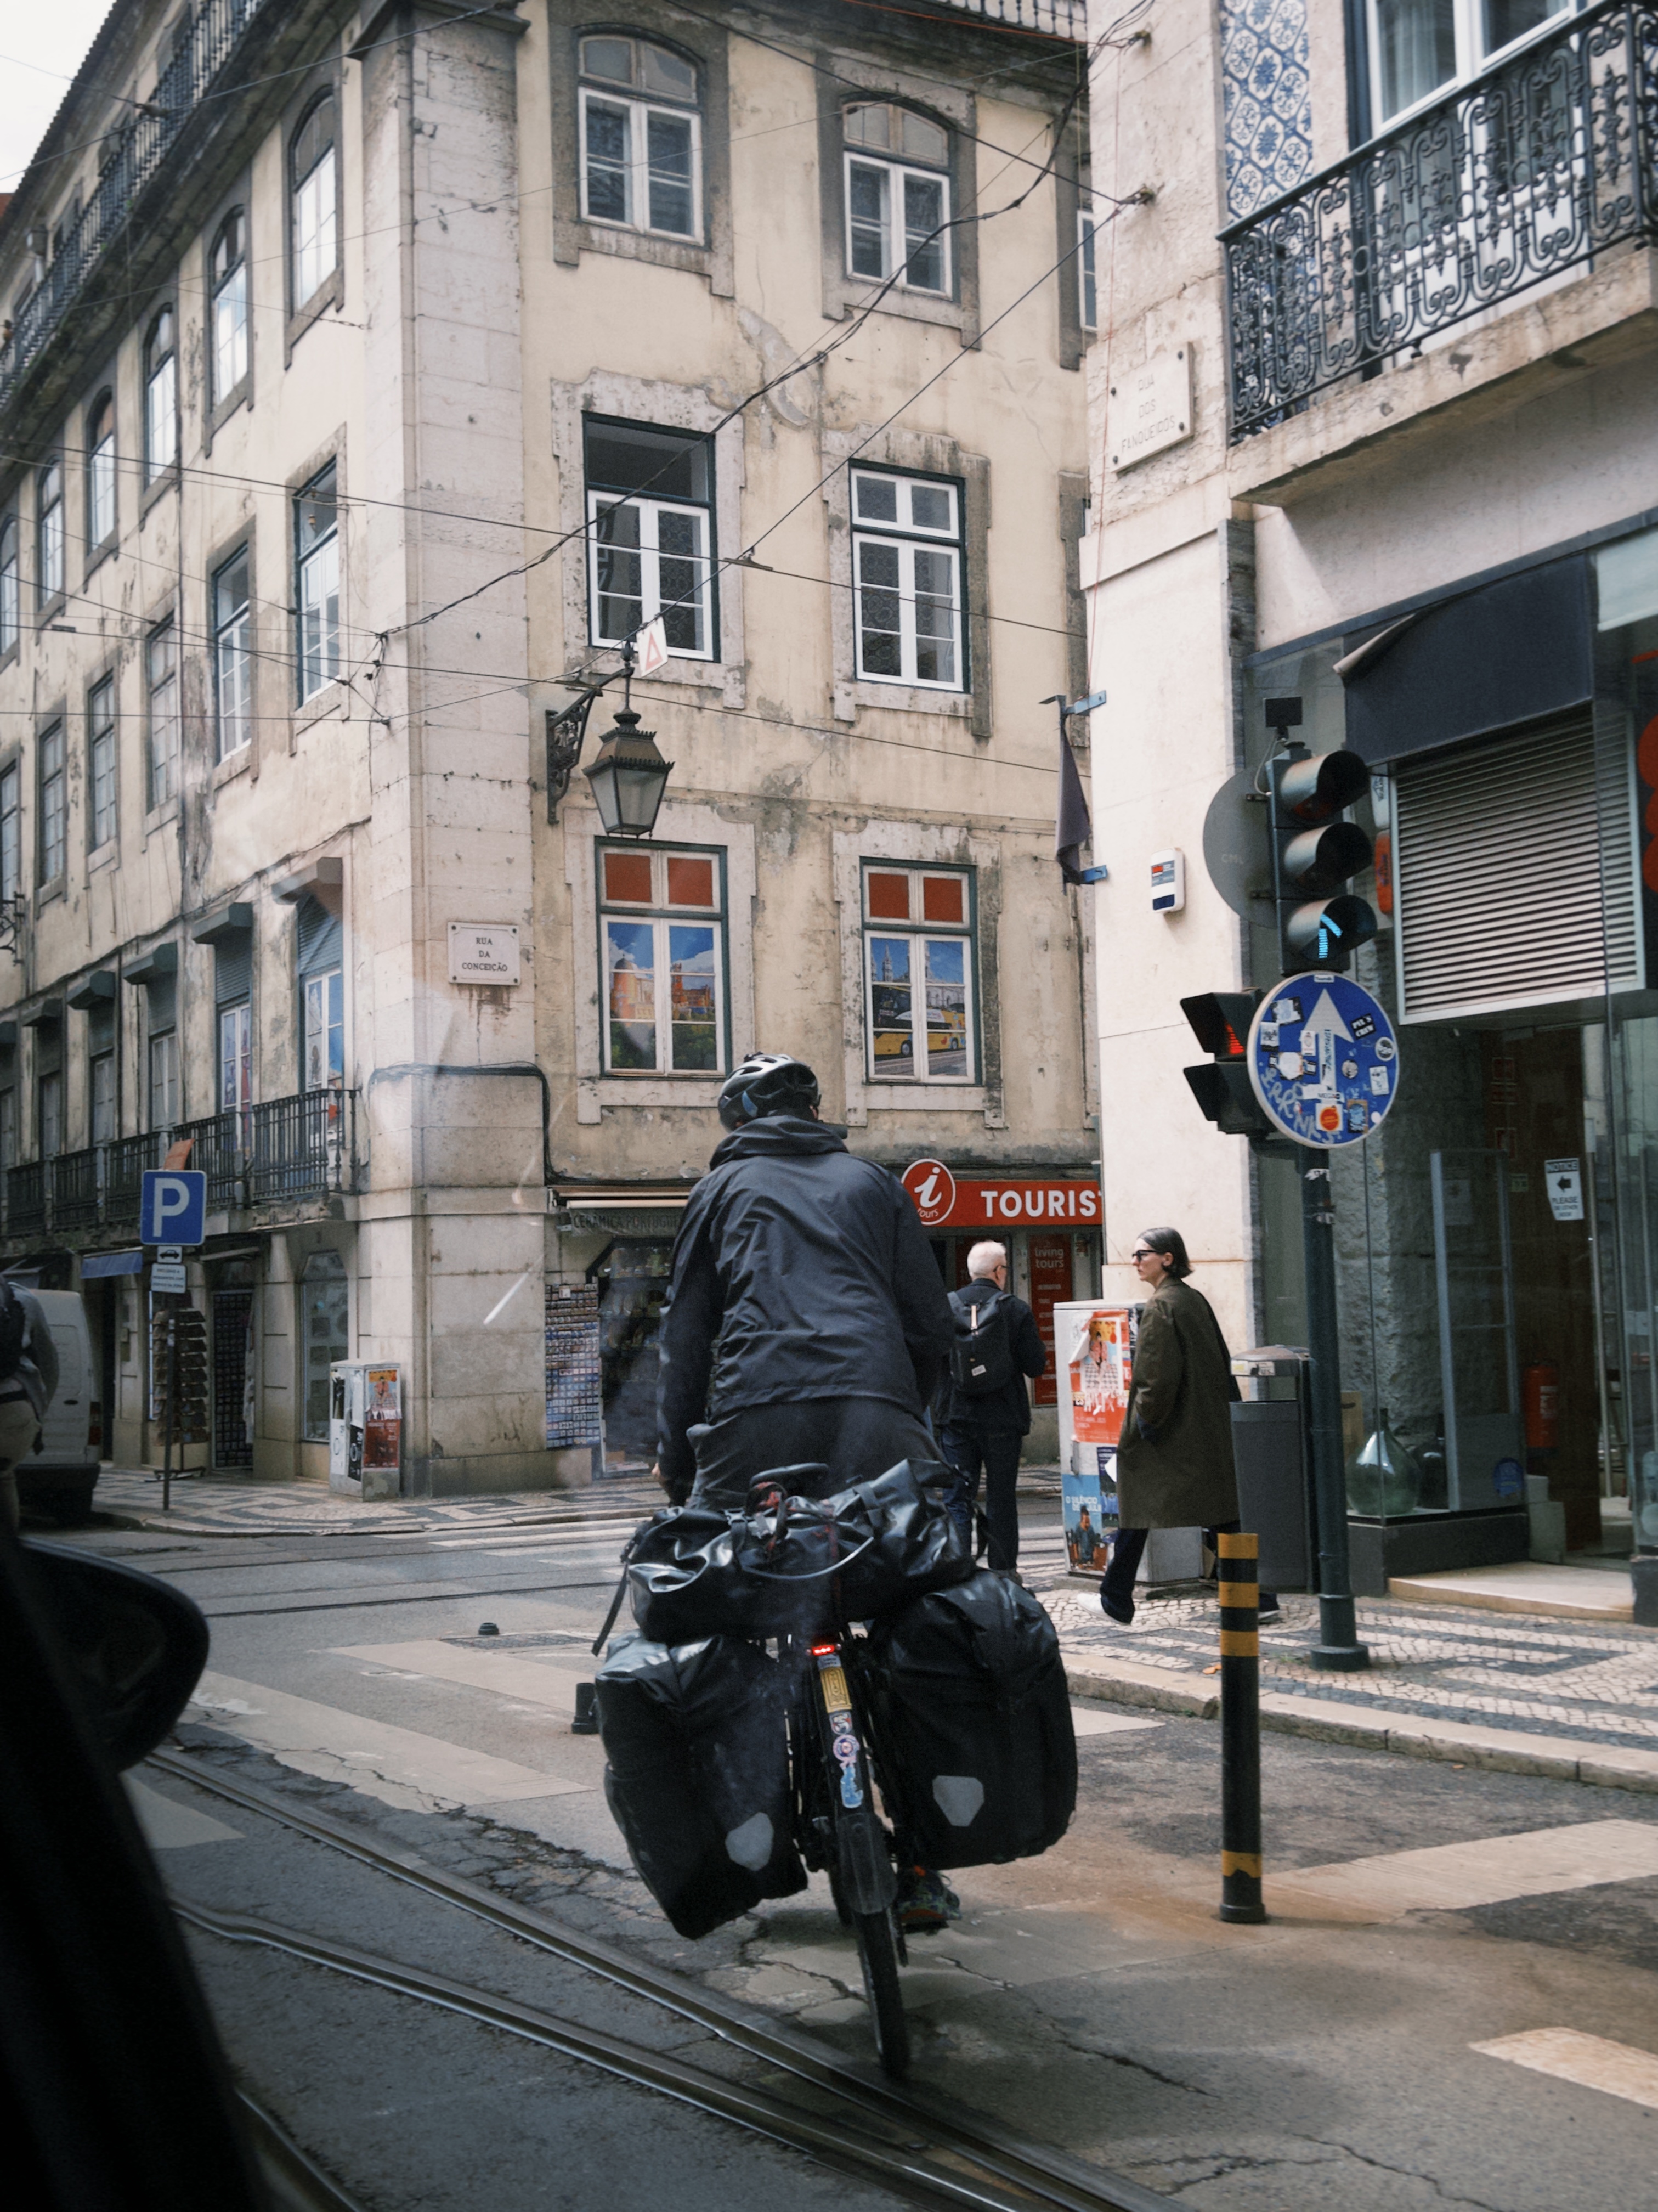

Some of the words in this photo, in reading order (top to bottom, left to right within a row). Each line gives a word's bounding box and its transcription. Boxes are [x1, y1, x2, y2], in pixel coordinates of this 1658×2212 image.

[1139, 399, 1156, 418] DOS
[476, 937, 493, 945] RUA
[1547, 1161, 1578, 1172] NOTICE
[152, 1178, 190, 1237] P
[981, 1190, 1102, 1217] TOURIS
[1035, 1246, 1064, 1259] living
[1035, 1259, 1065, 1268] tours
